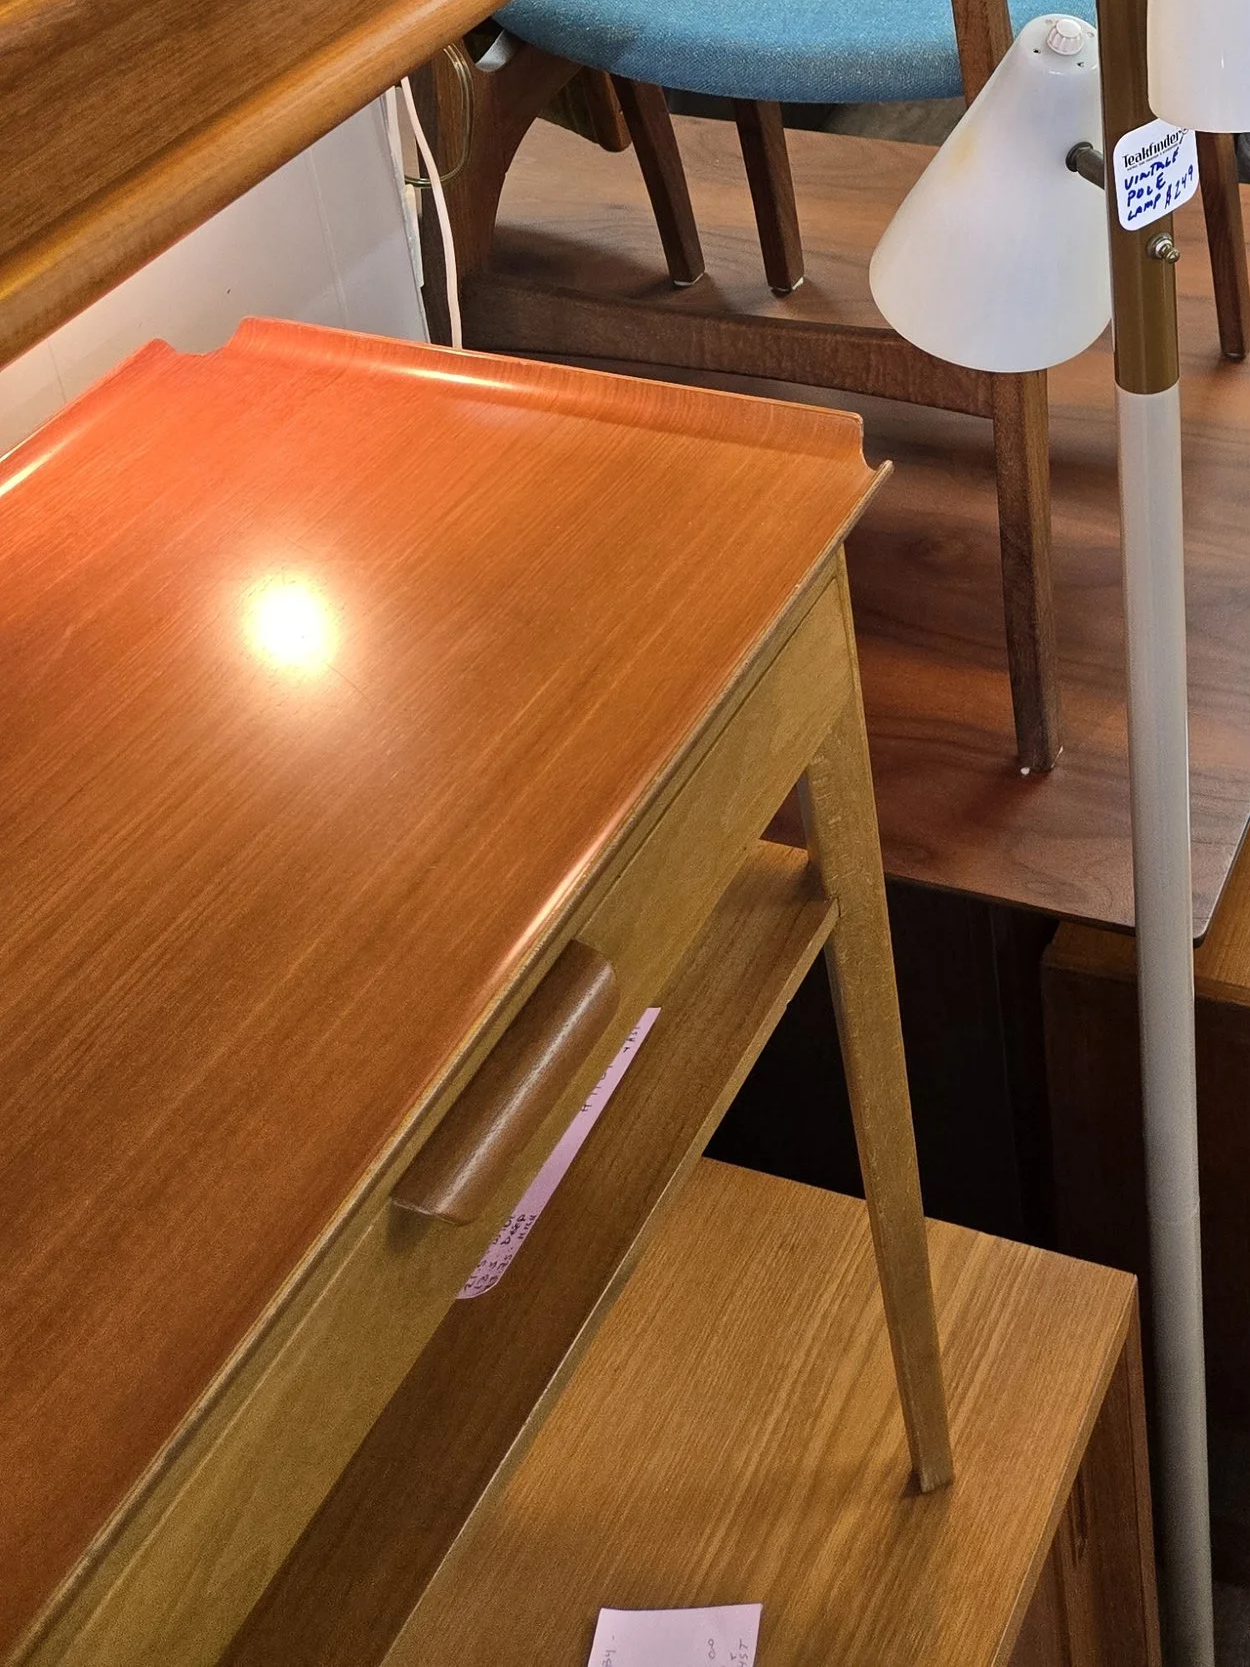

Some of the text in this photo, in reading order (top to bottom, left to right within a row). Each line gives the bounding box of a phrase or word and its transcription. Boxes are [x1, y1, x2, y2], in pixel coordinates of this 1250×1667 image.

[1122, 130, 1182, 168] Teakfinder
[1124, 146, 1180, 191] VINTAGE
[1127, 171, 1167, 208] POLE
[1127, 192, 1162, 222] LAMP
